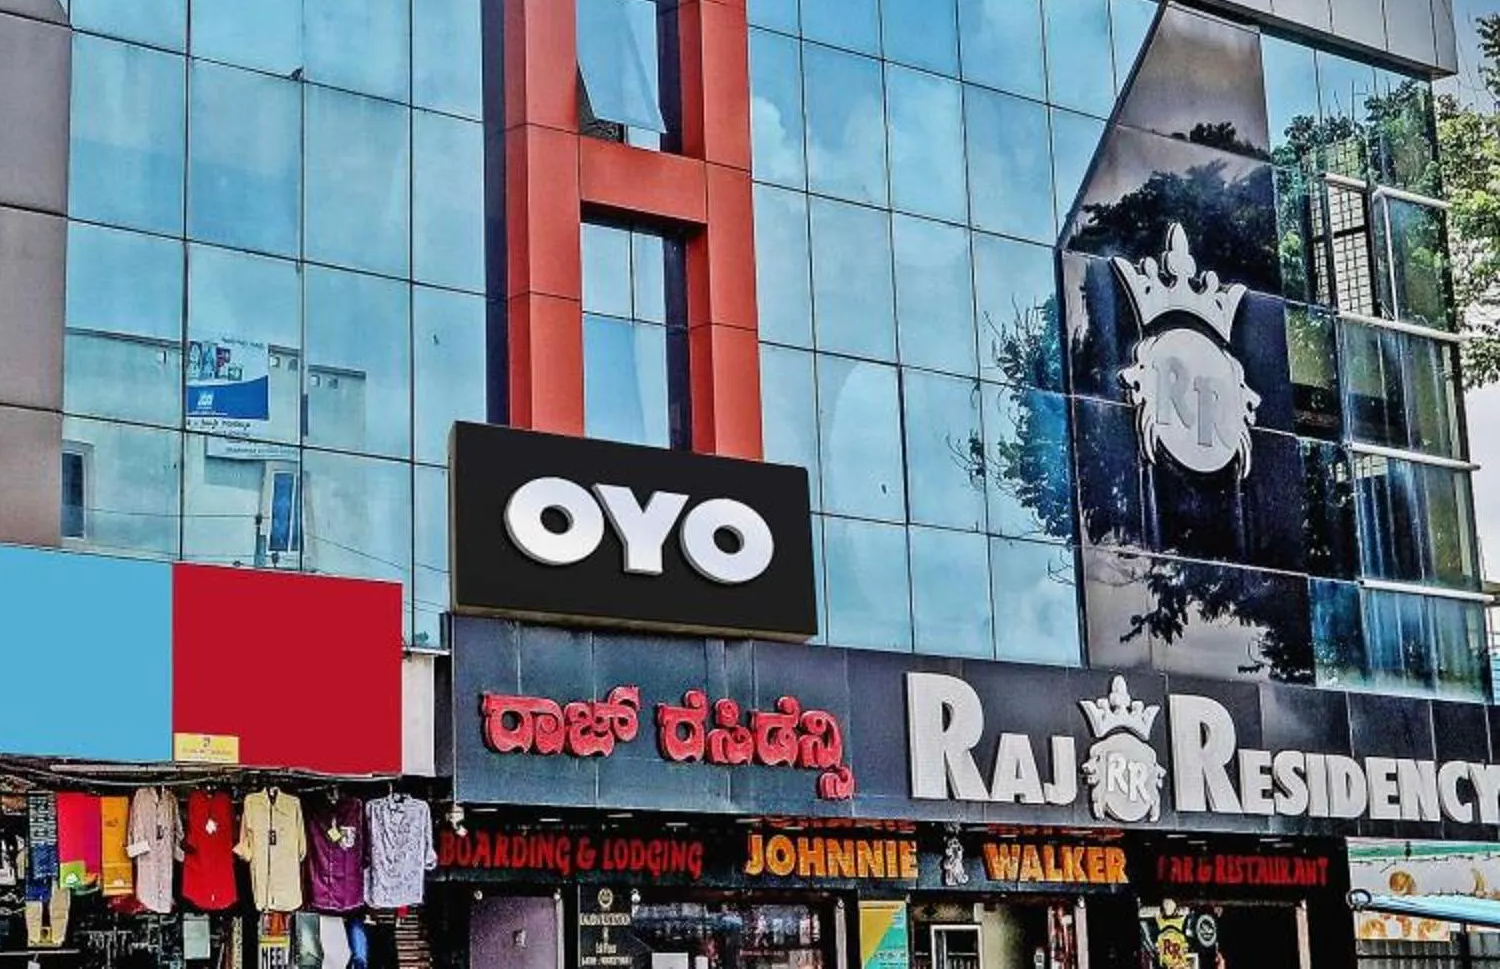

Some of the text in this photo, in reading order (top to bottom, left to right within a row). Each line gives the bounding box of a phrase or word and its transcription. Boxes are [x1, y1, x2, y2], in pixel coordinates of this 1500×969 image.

[506, 476, 775, 585] OYO
[482, 684, 641, 757] ರಾಜ್
[906, 671, 1500, 825] RAJ RR RESIDENCY
[437, 829, 706, 879] BOARDING & LODGING
[744, 834, 1130, 884] JOHNNIE WALKER
[1214, 854, 1330, 888] RESTAURANT
